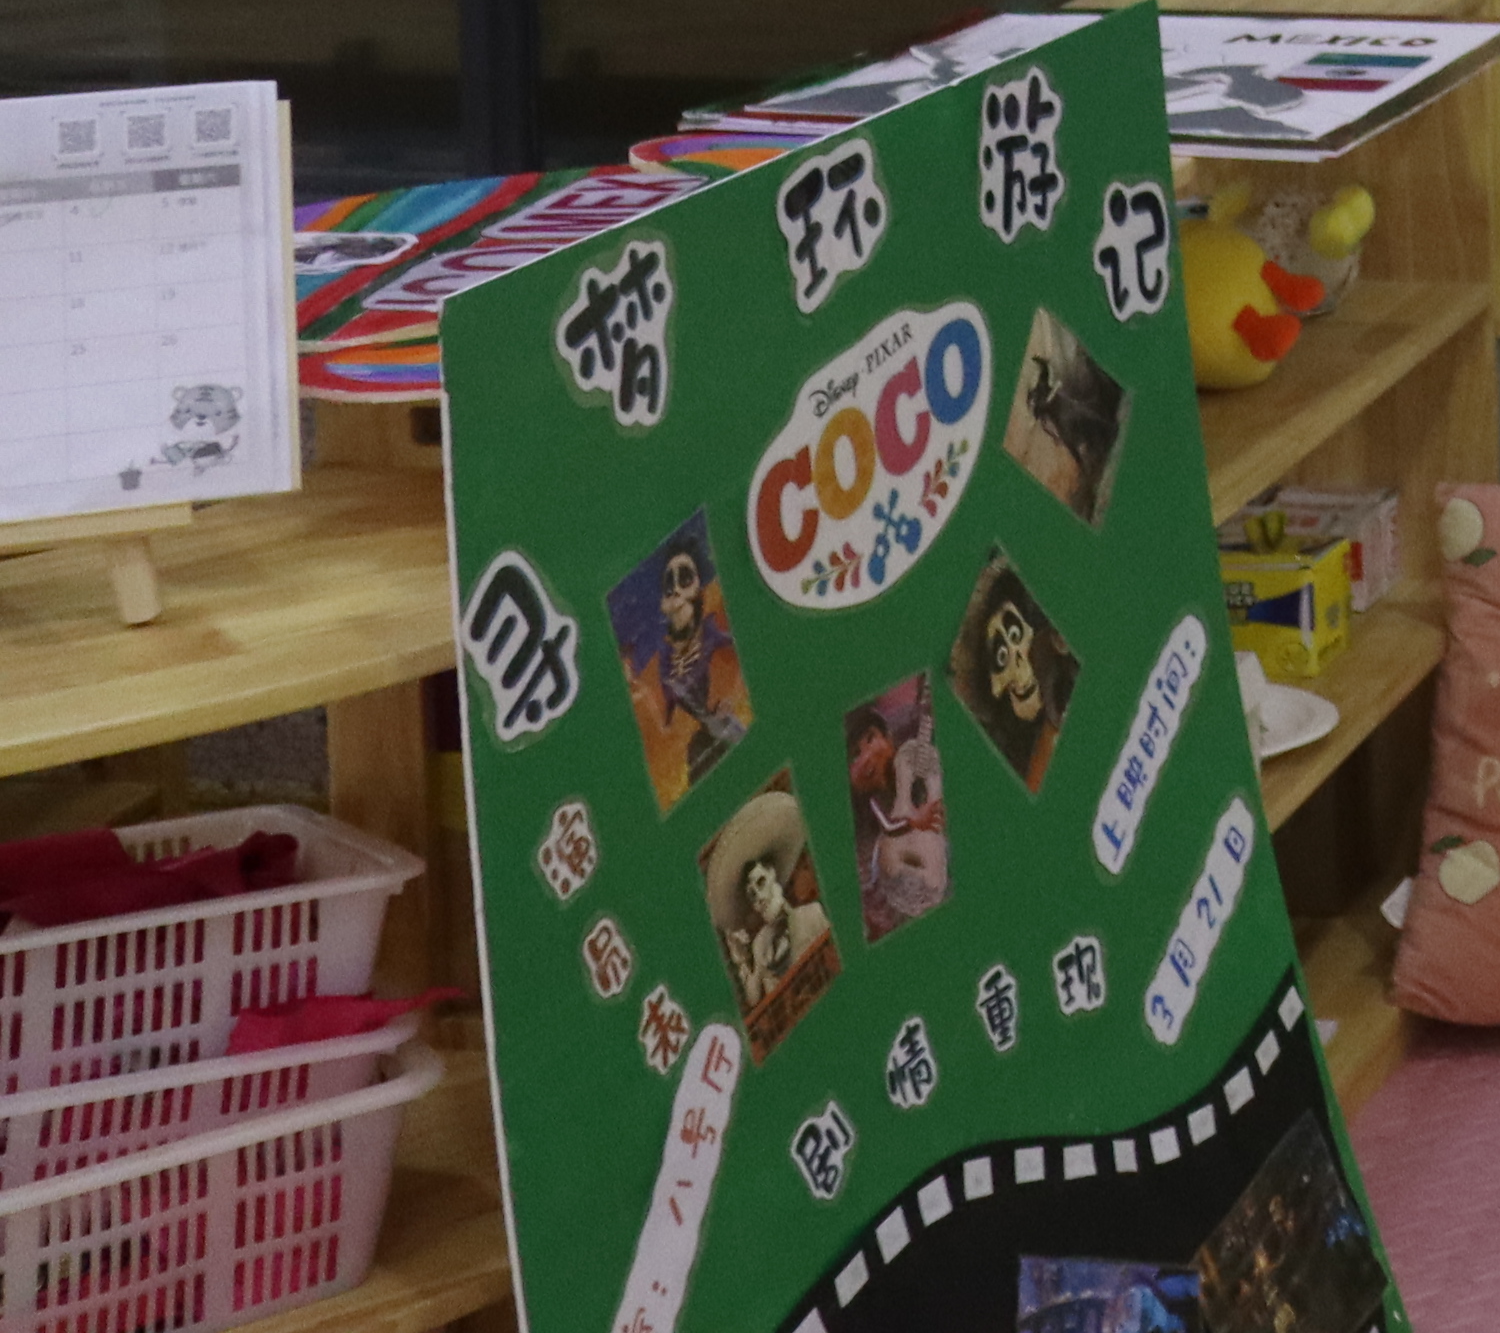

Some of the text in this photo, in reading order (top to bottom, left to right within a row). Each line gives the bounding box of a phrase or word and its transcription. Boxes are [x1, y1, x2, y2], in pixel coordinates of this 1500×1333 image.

[470, 74, 1168, 729] 寻梦环游记
[755, 318, 982, 573] COCO
[864, 323, 914, 375] PIXAR
